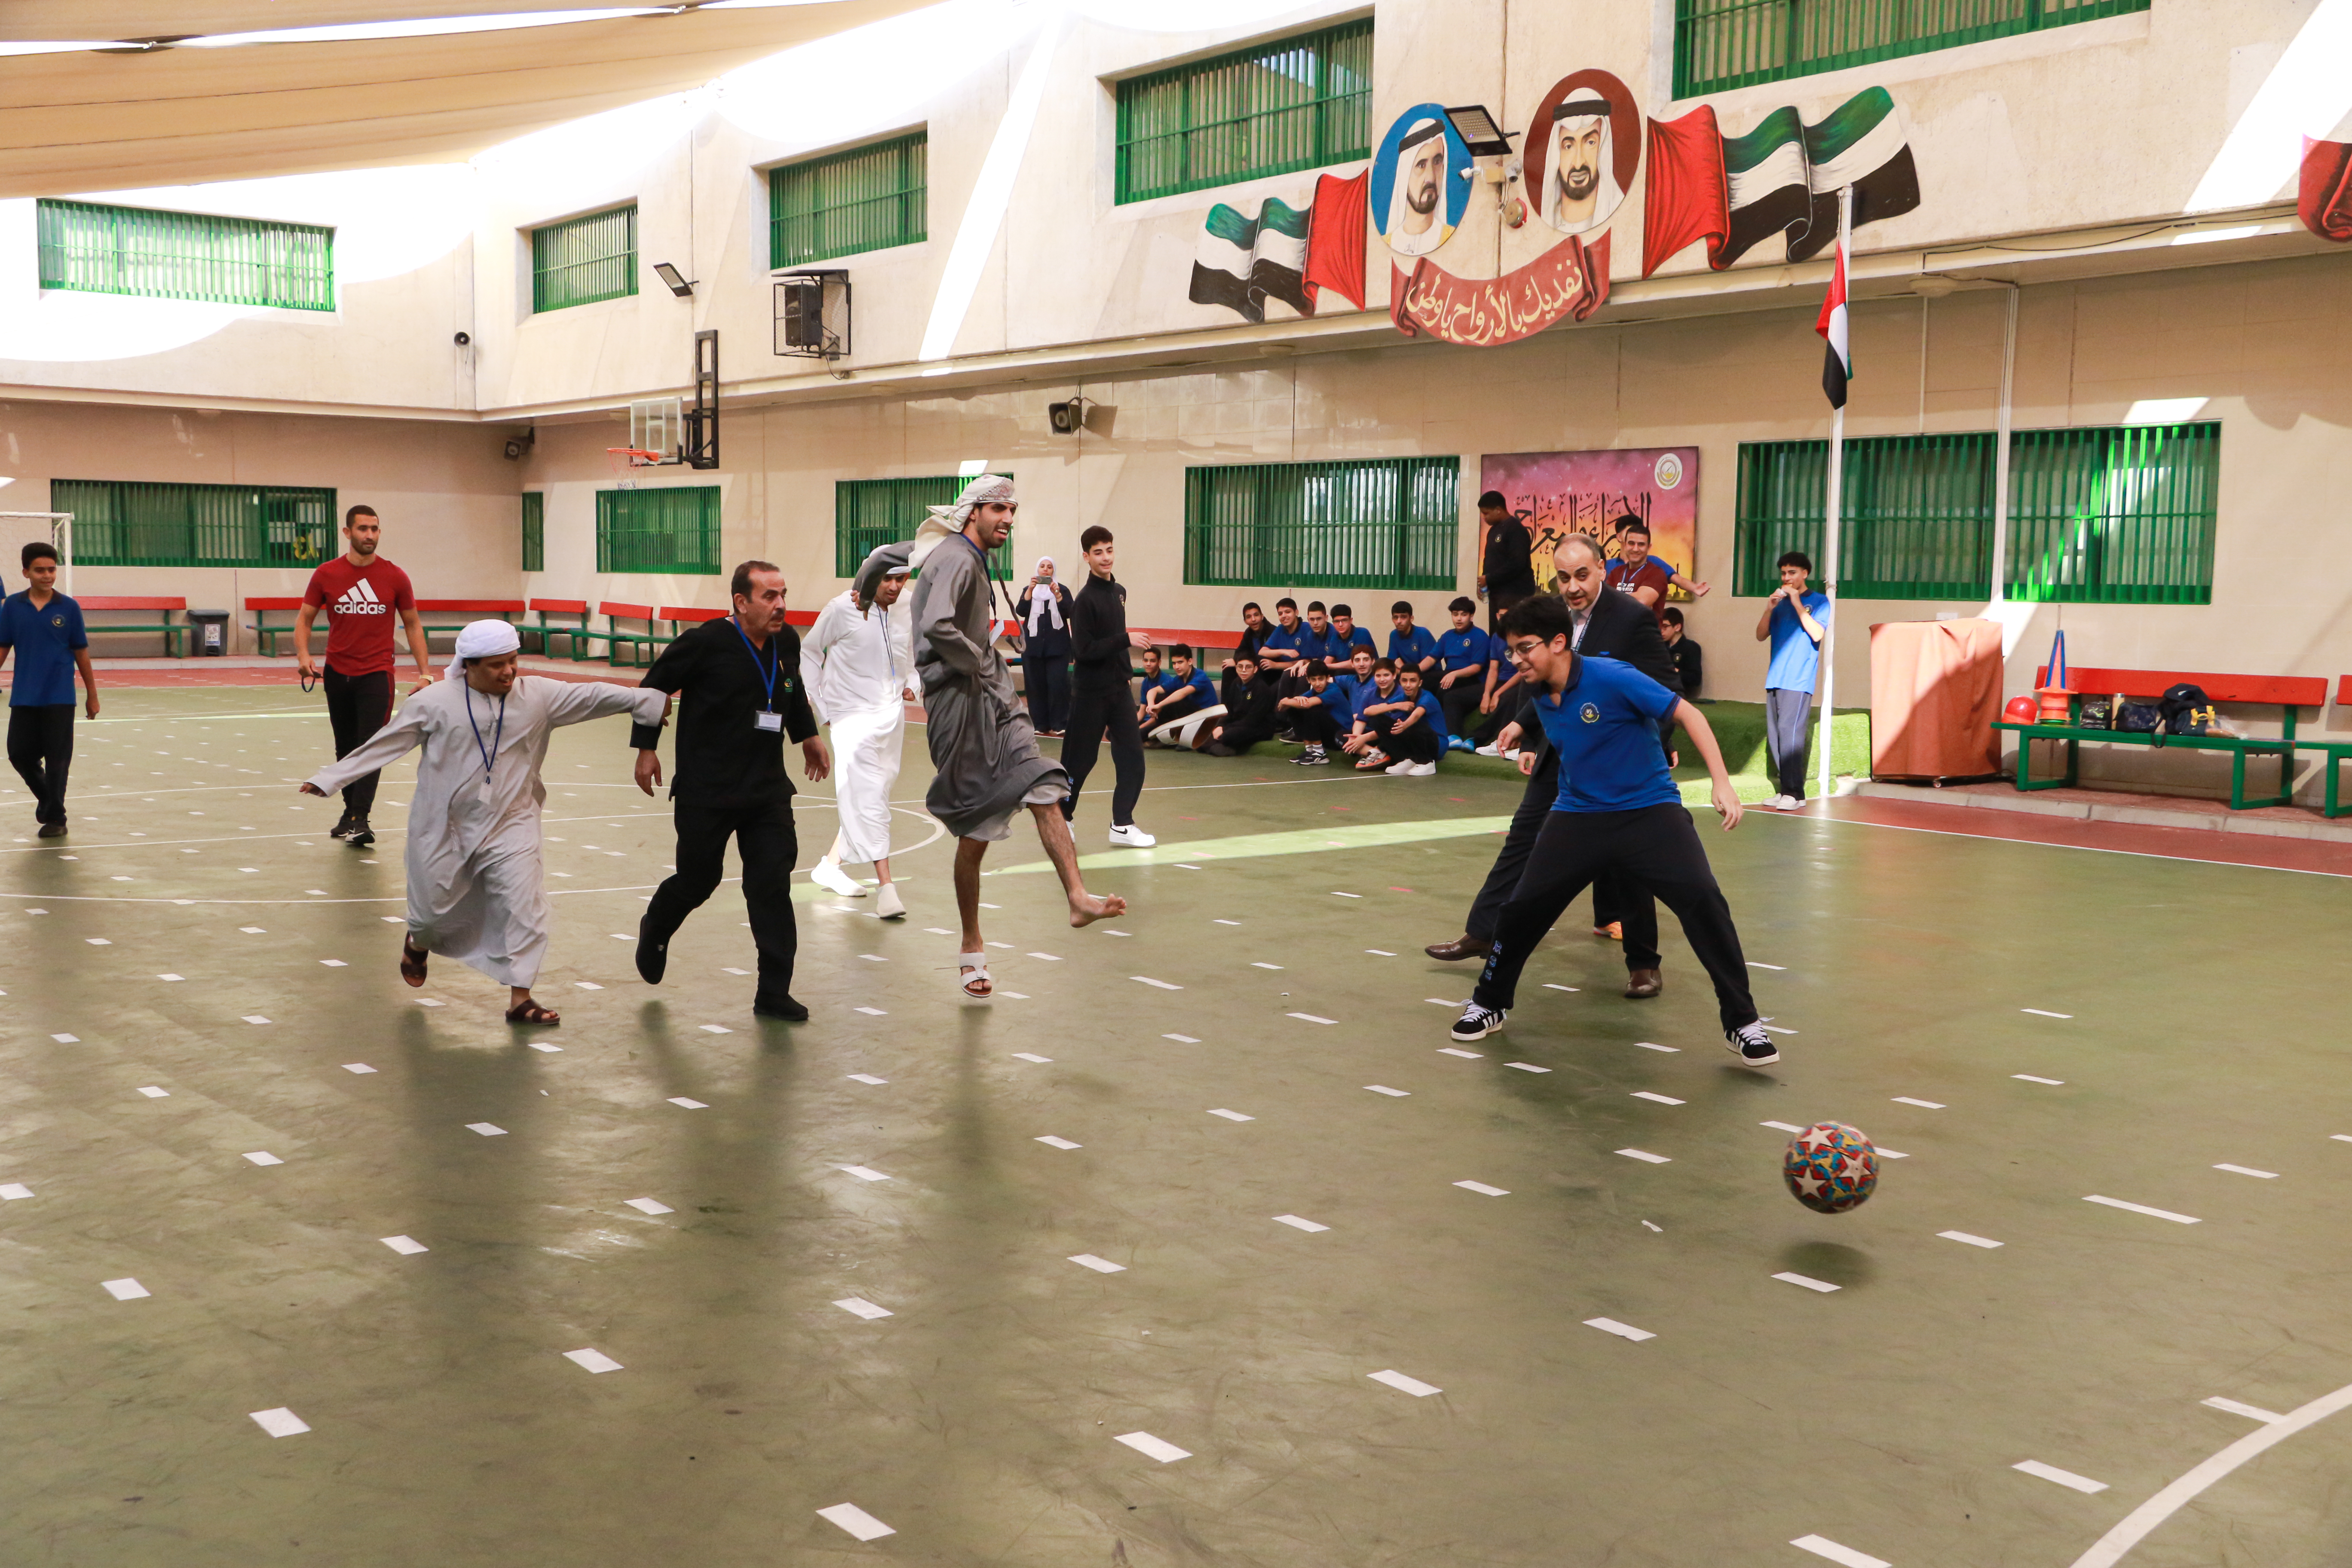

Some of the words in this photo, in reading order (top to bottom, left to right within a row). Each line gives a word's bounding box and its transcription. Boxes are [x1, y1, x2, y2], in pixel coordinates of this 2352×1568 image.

[1450, 284, 1528, 345] بالأرواح
[1522, 259, 1583, 320] نفديك
[334, 601, 386, 615] adidas
